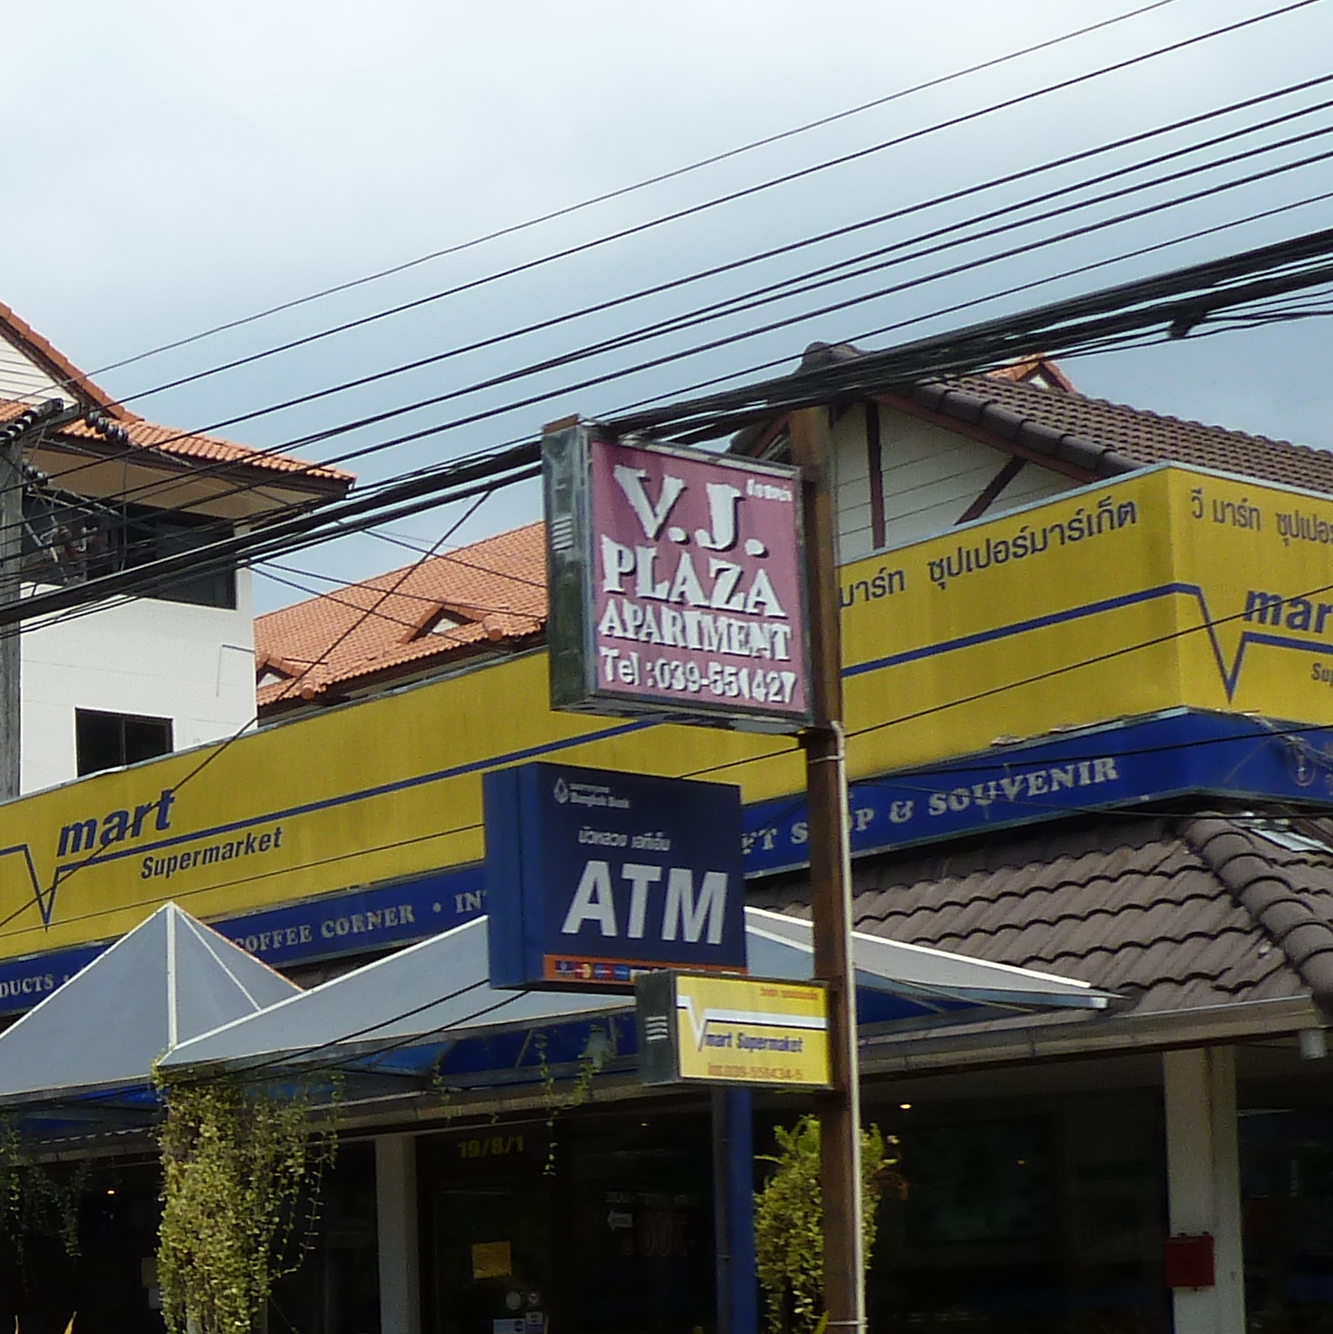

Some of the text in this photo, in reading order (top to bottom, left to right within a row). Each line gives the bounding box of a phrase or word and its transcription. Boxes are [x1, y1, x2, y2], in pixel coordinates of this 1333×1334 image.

[601, 534, 788, 617] PLAZA
[927, 495, 1137, 590] ซุปเปอร์มาร์เก็ต
[599, 598, 792, 660] APARTMENT
[56, 788, 176, 857] mart
[141, 826, 283, 879] Supermarket
[321, 905, 415, 939] CORNER
[889, 801, 915, 823] &
[929, 757, 1120, 817] SOUVENIR
[561, 860, 729, 945] ATM
